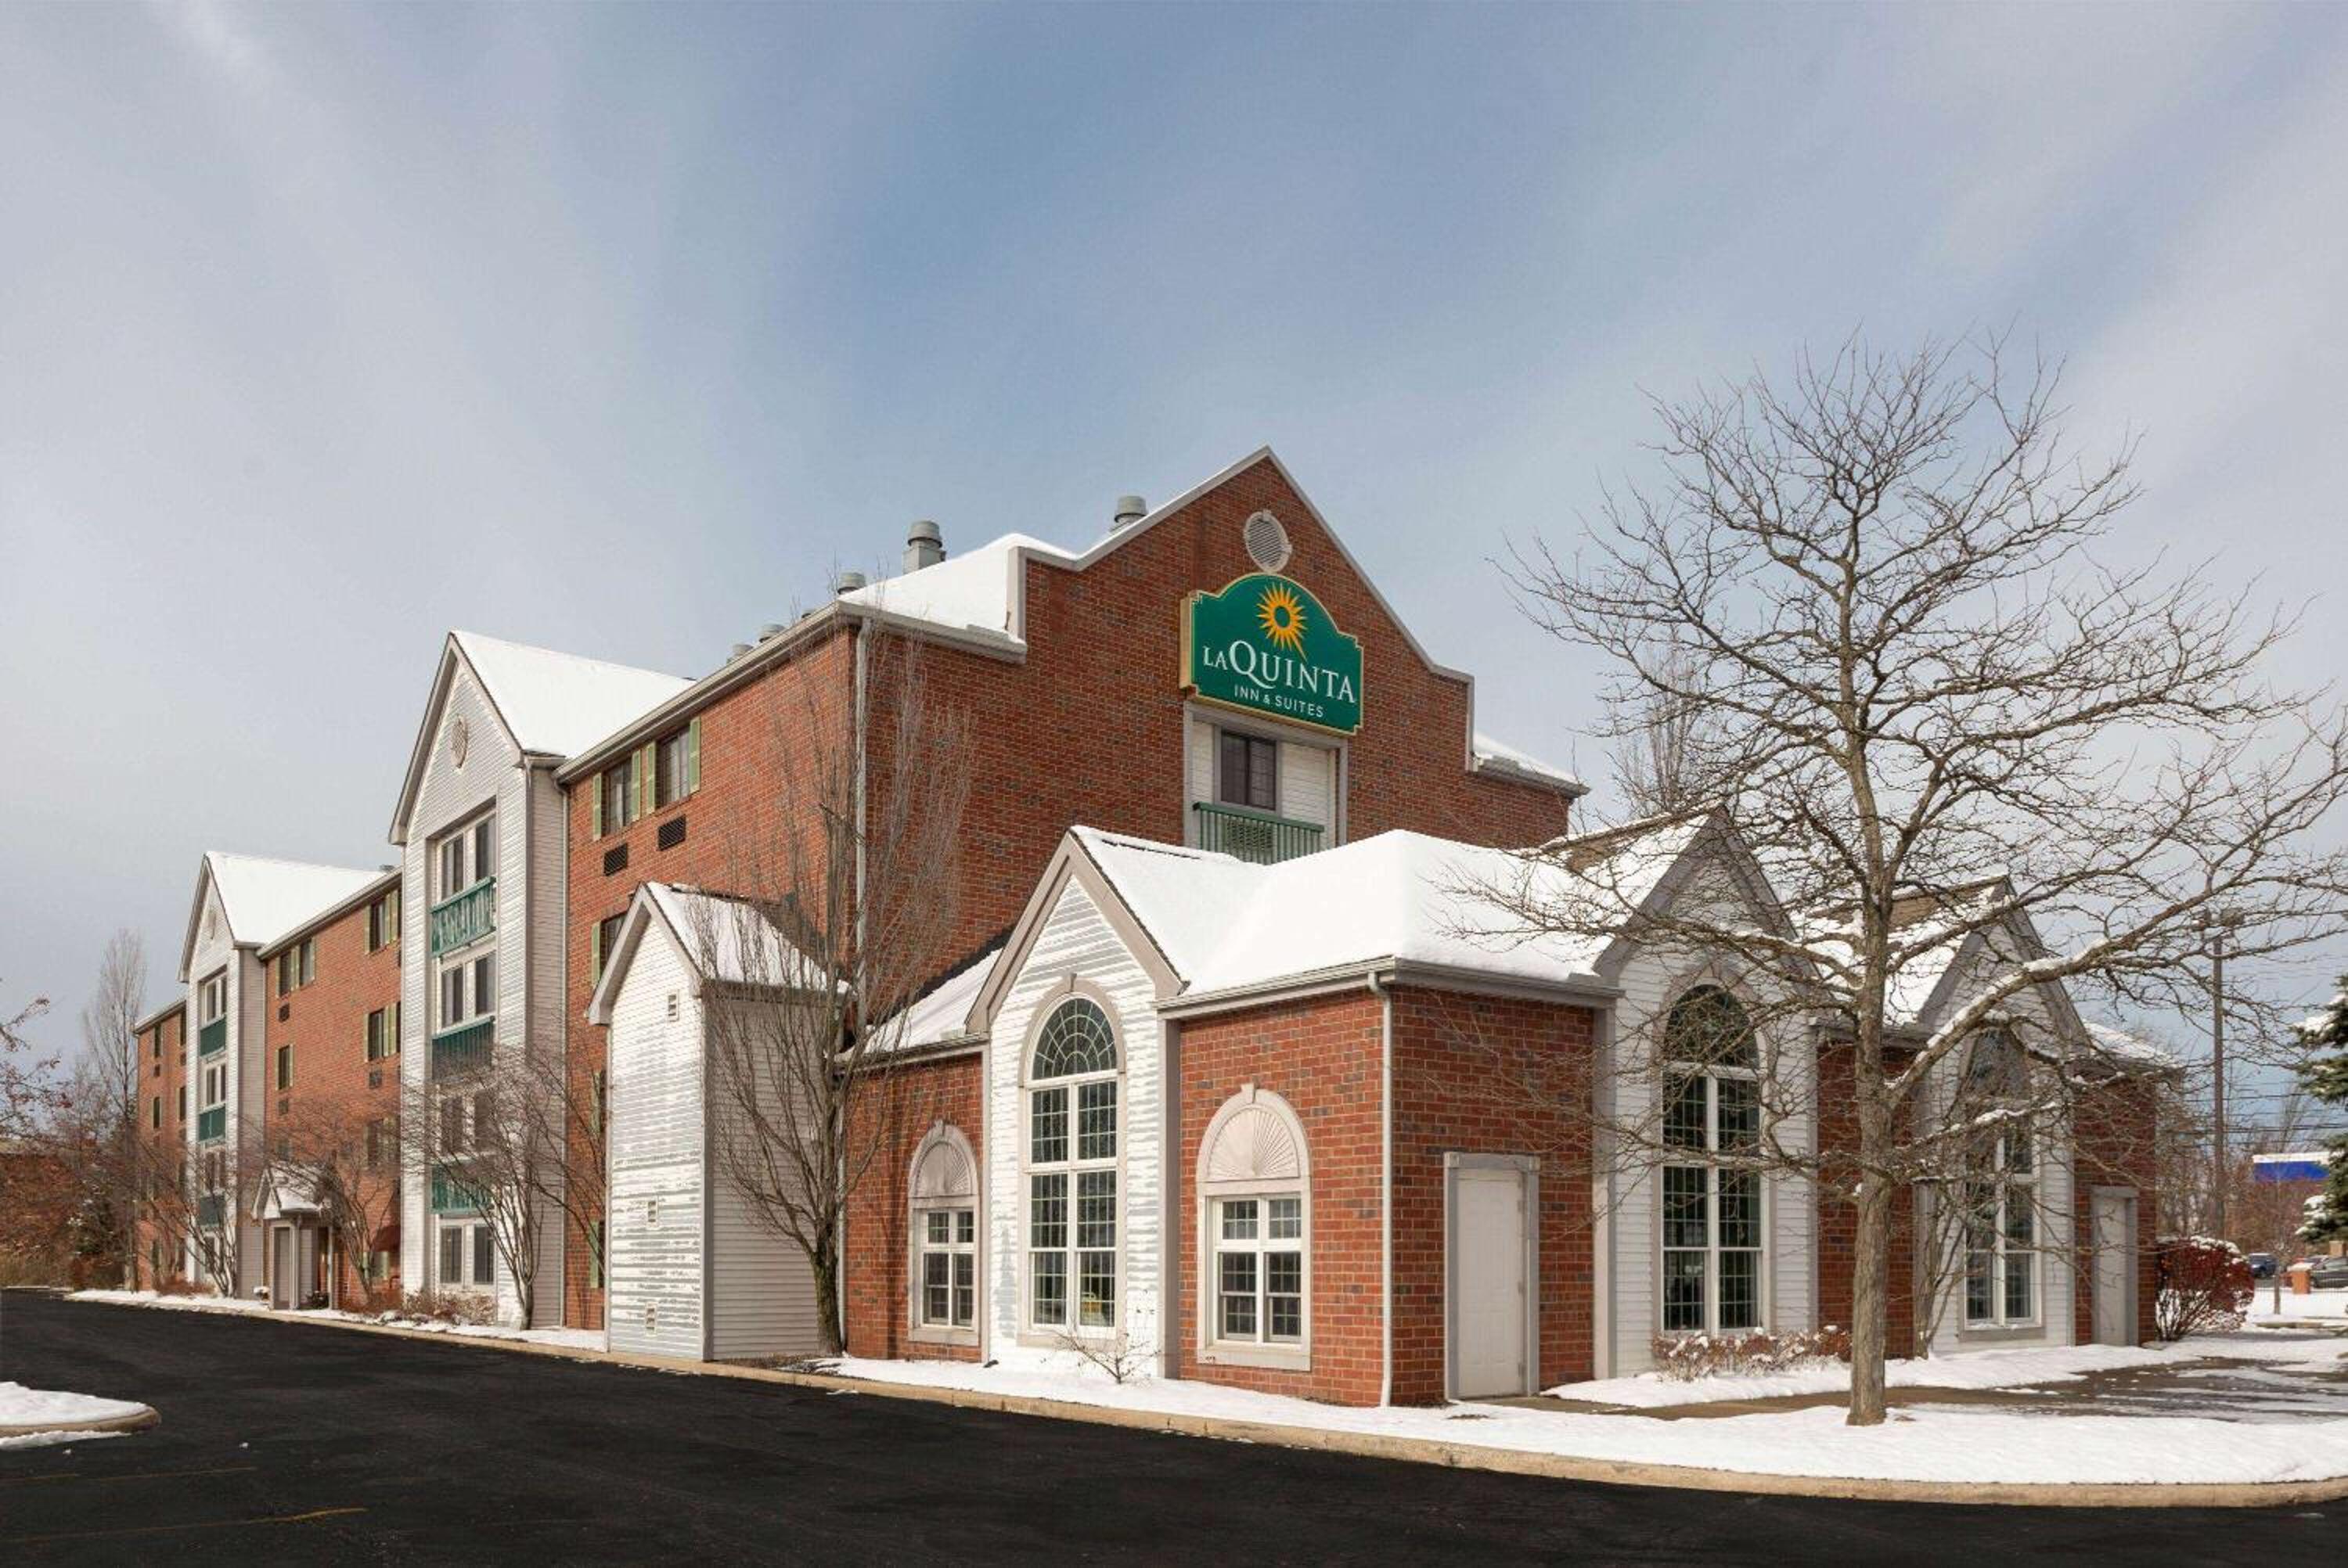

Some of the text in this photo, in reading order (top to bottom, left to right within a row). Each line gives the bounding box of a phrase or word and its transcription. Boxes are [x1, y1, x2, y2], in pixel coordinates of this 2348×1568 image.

[1203, 640, 1356, 703] LA QUINTA
[1234, 685, 1323, 717] INN & SUITES
